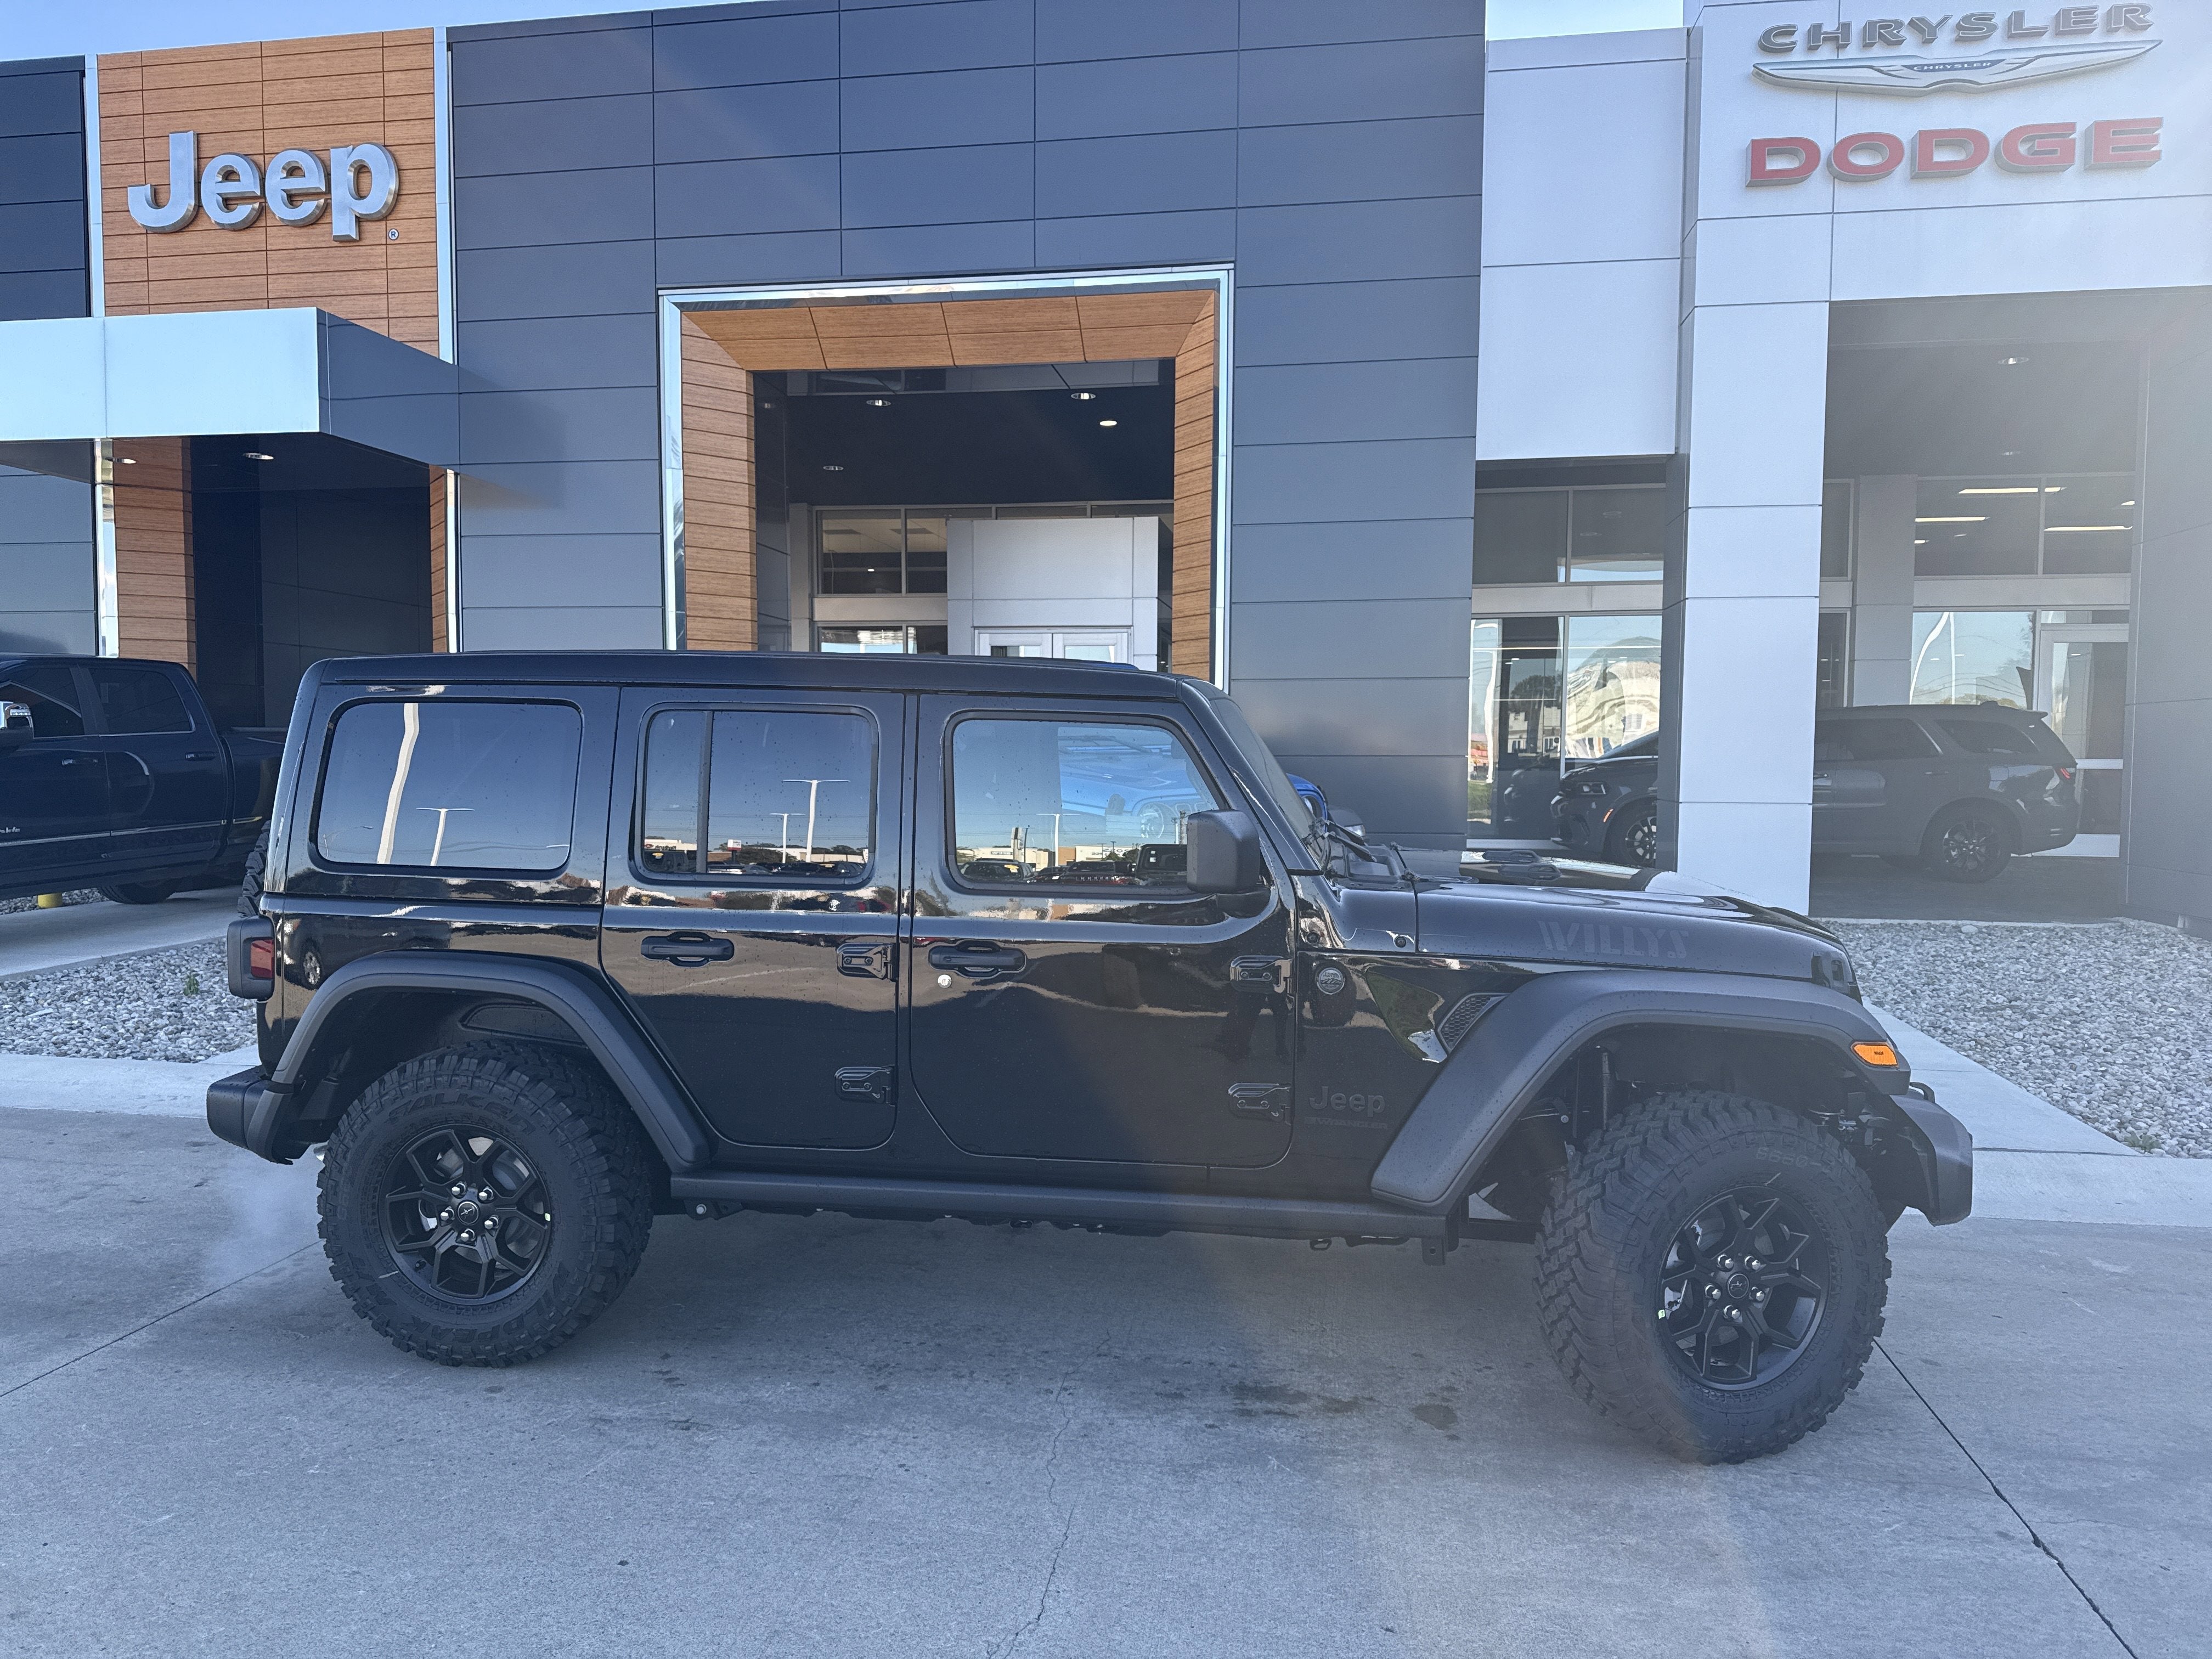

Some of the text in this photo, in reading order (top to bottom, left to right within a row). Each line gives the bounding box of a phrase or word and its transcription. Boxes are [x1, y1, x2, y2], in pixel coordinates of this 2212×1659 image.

[1758, 3, 2153, 52] CHRYSLER
[1913, 62, 1991, 71] CHRYSLER
[1746, 117, 2163, 187] DODGE
[127, 130, 399, 242] Jeep
[1538, 921, 1689, 959] WILLYS
[1310, 1086, 1386, 1118] Jeep
[1316, 1117, 1388, 1130] WRANGLER
